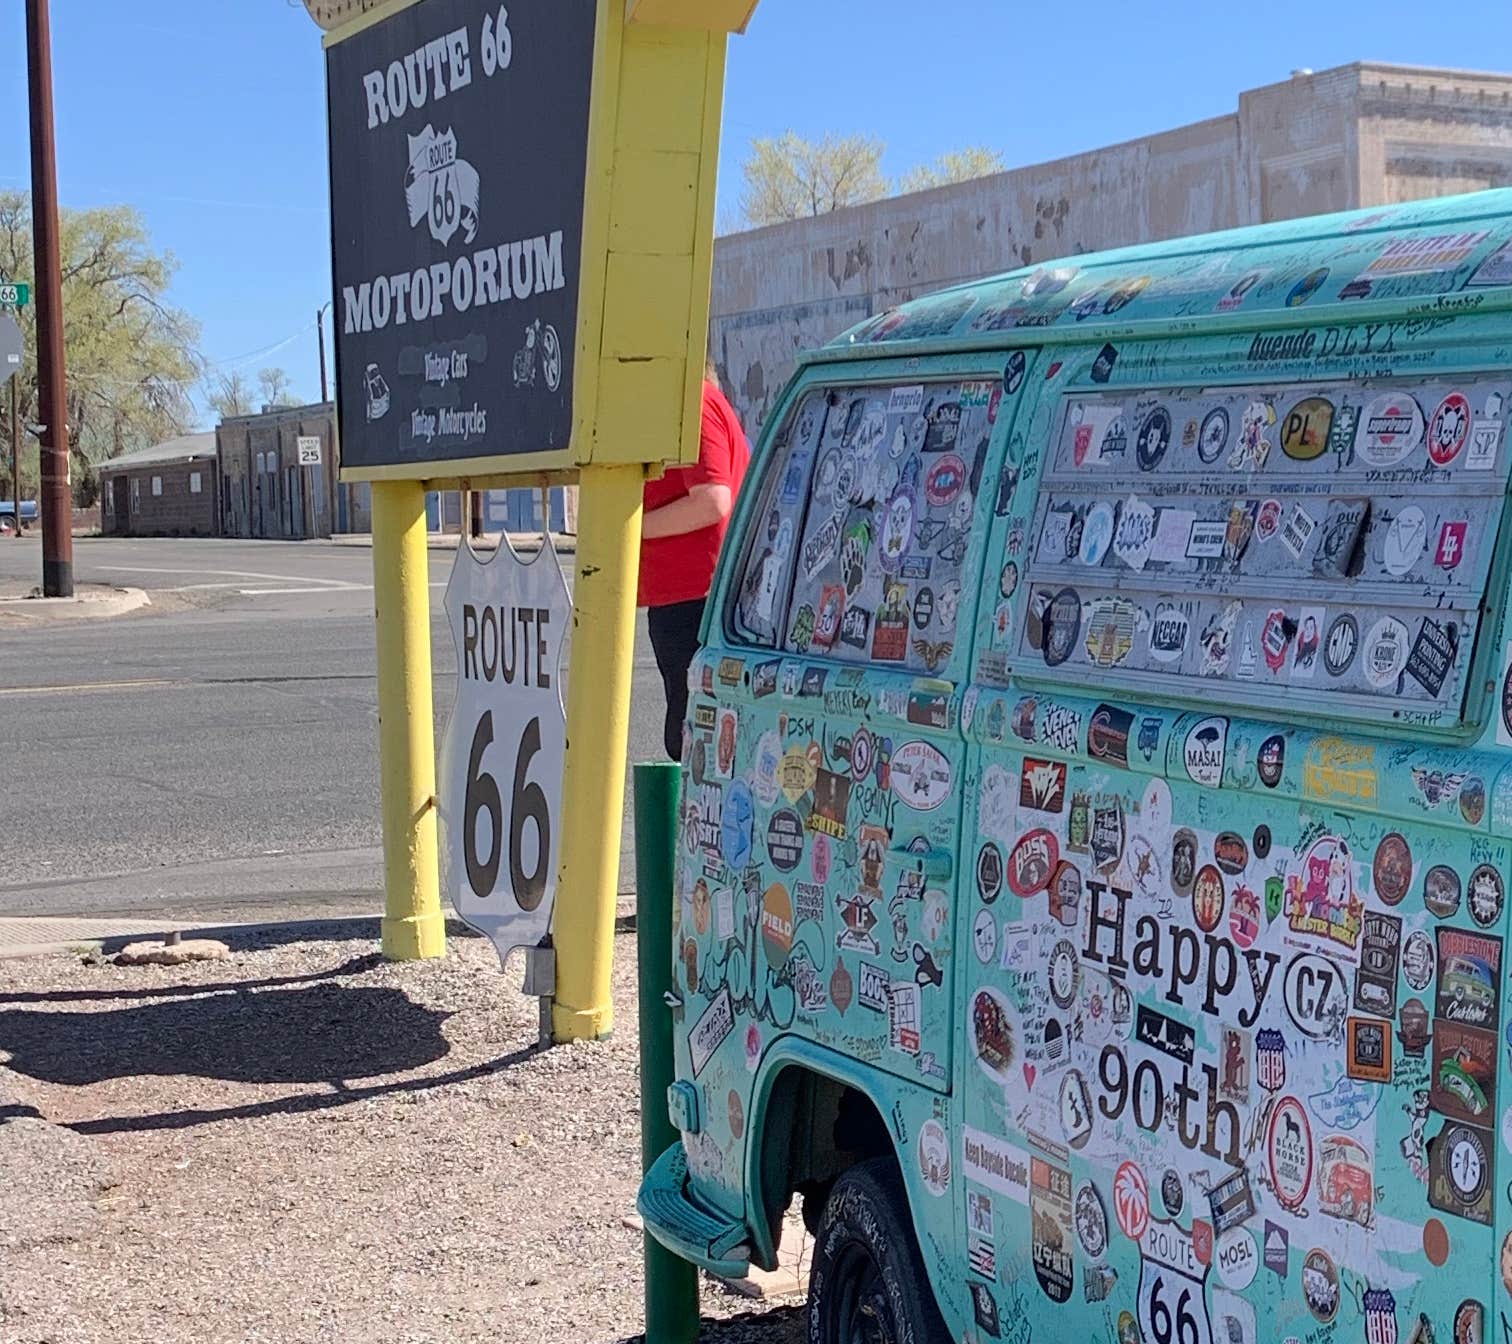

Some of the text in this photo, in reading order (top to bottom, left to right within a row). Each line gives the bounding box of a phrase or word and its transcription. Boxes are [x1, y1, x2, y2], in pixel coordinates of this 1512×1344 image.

[363, 4, 512, 129] ROUTE 66
[428, 139, 453, 167] ROUTE
[433, 169, 454, 227] 66
[2, 287, 16, 301] 66
[343, 230, 565, 334] MOTOPORIUM
[451, 349, 468, 378] Cars
[438, 402, 486, 441] Motorcycles
[302, 450, 319, 462] 25
[463, 604, 549, 689] ROUTE
[1187, 752, 1221, 768] MASAI
[463, 709, 550, 912] 66
[763, 911, 792, 935] FIELD
[1082, 881, 1281, 1028] Happy
[1296, 965, 1333, 1022] CZ
[1098, 1043, 1245, 1169] 90th
[1276, 1137, 1305, 1155] BLACK
[1276, 1149, 1306, 1167] HORSE
[1149, 1227, 1195, 1270] ROUTE
